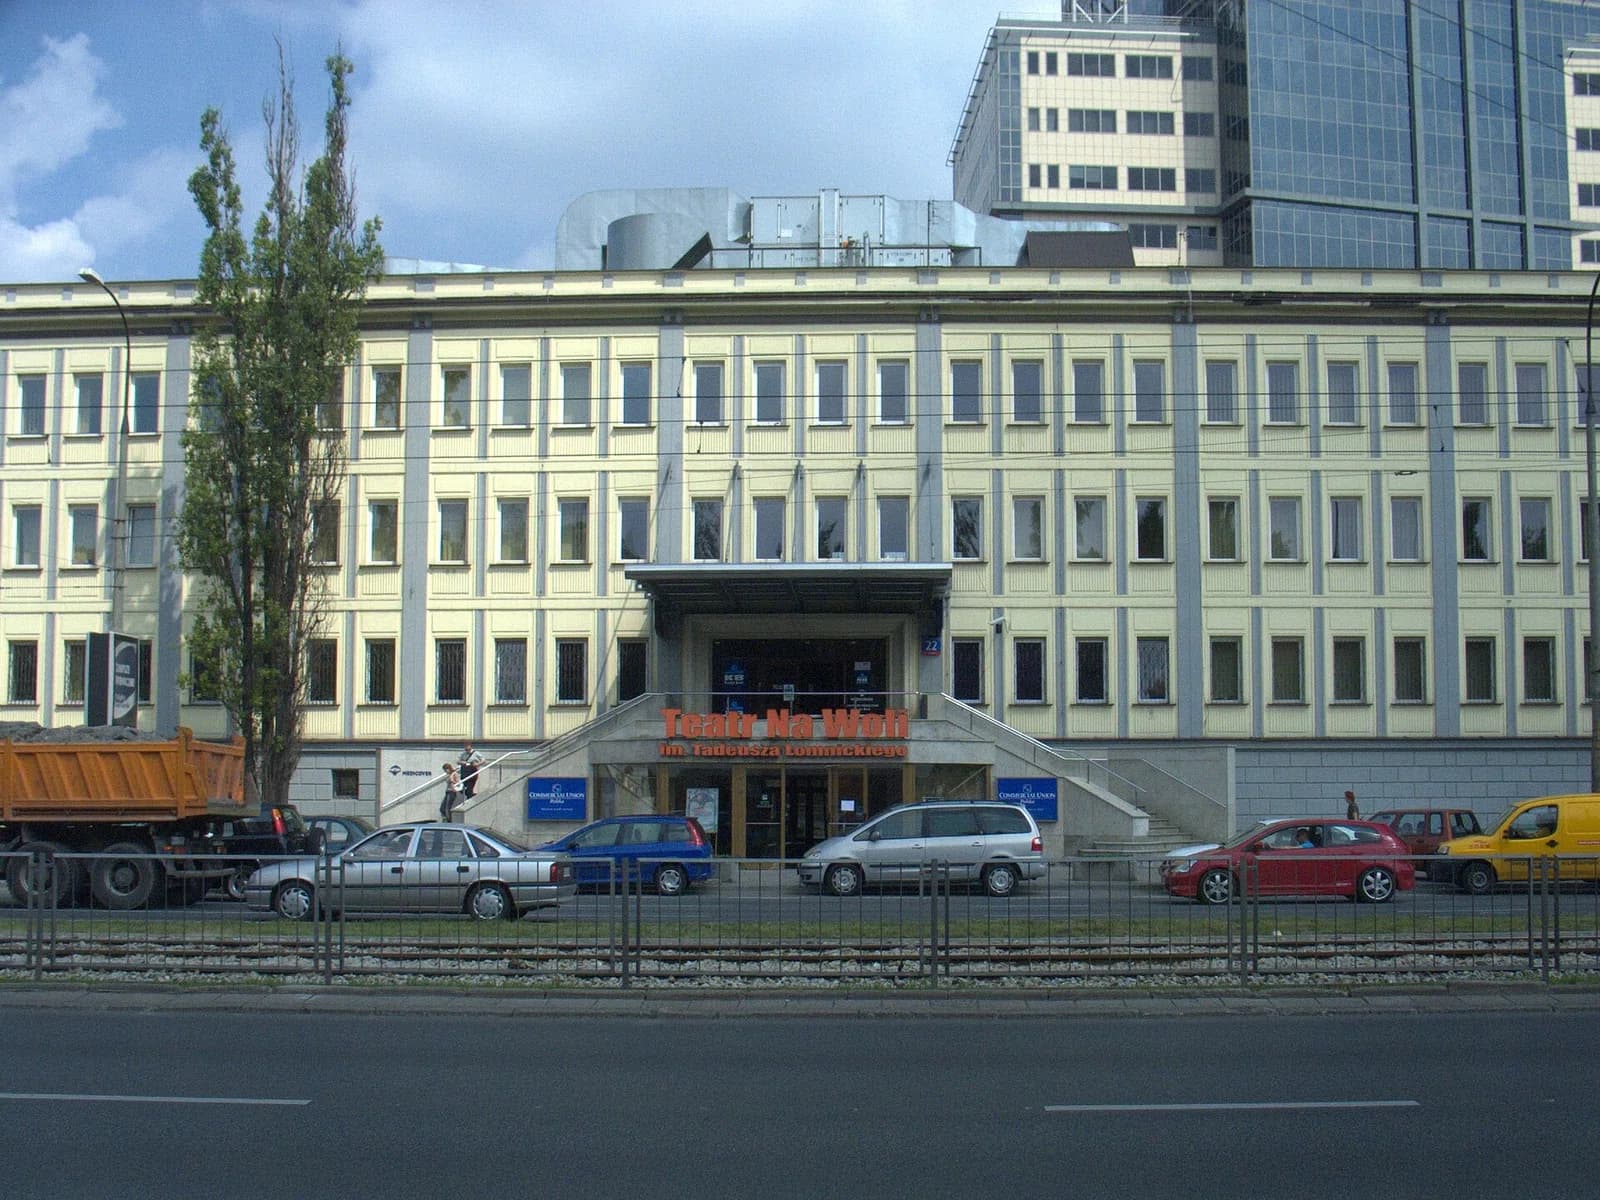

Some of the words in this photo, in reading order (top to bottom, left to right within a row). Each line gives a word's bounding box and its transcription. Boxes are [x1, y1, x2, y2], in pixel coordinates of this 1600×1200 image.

[925, 640, 938, 651] 22
[659, 708, 757, 738] Teatr
[767, 708, 813, 738] Na
[822, 708, 908, 738] Woli
[692, 743, 780, 757] Tadeusza
